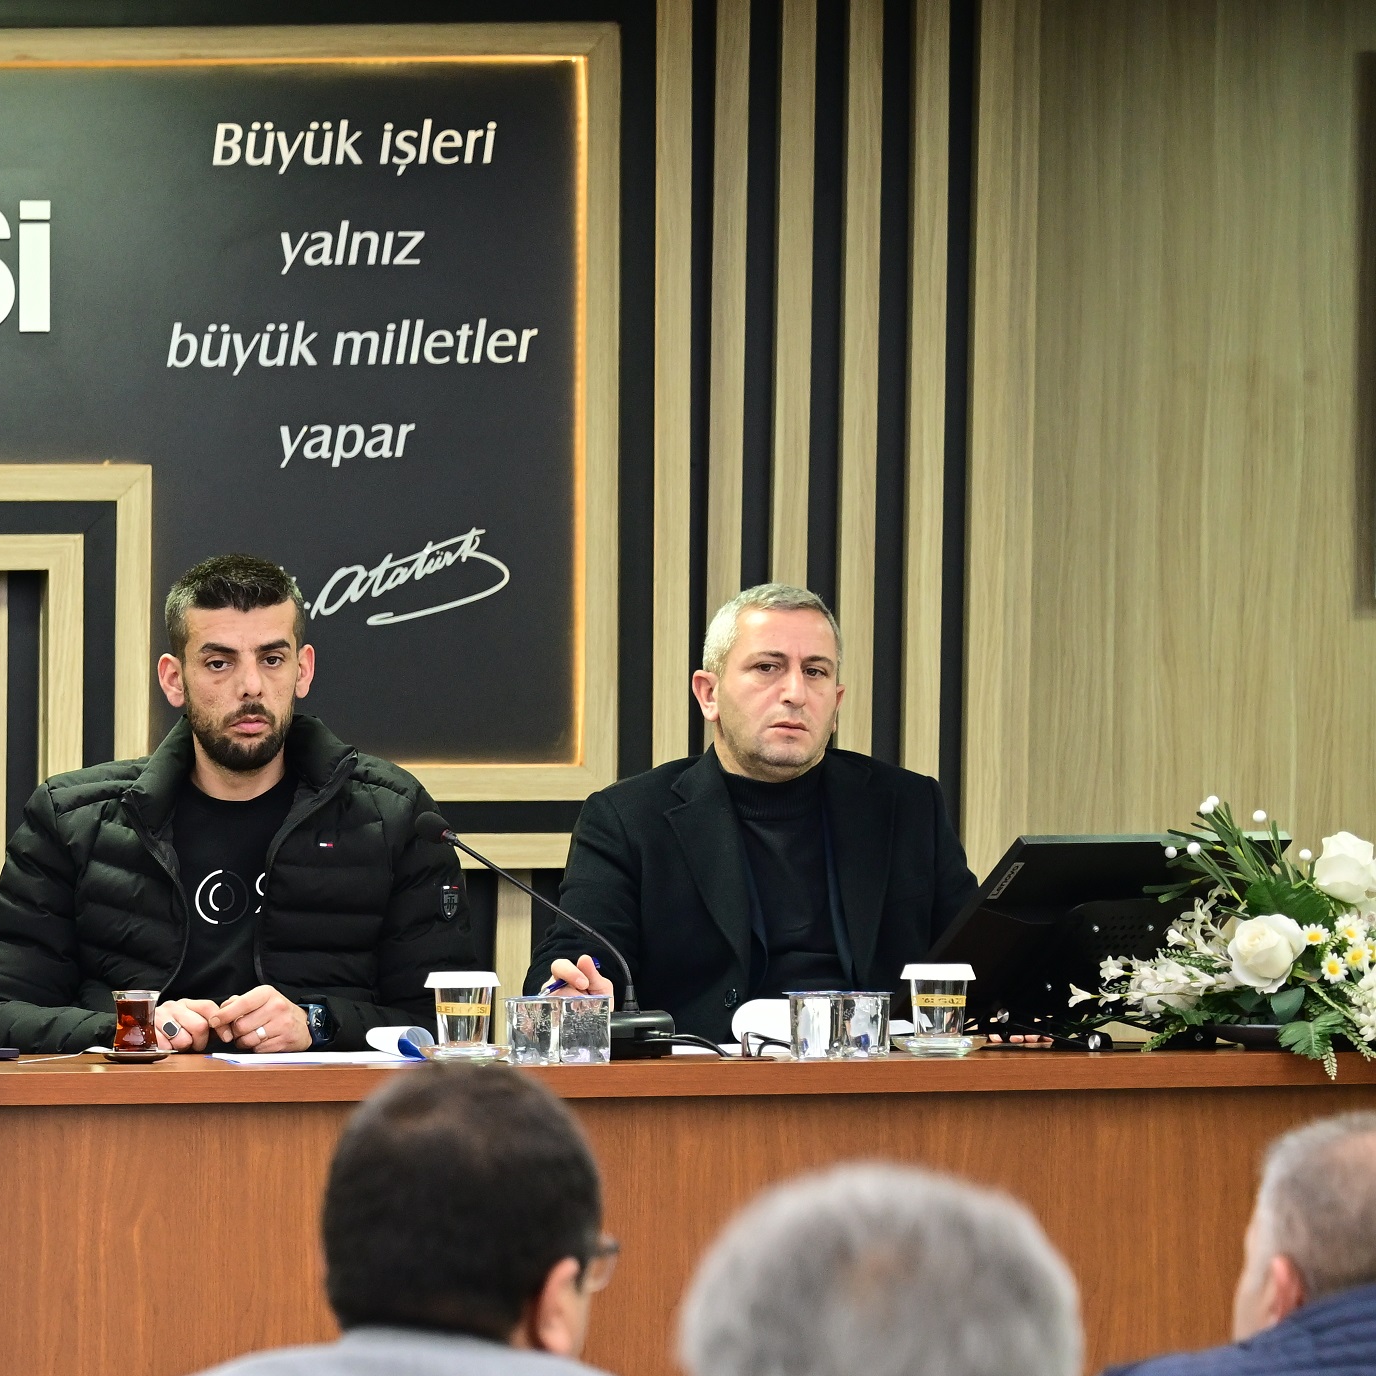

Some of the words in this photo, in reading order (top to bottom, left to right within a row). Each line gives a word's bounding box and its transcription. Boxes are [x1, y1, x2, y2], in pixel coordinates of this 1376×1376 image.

[212, 119, 363, 175] Büyük
[379, 119, 498, 176] işleri
[280, 220, 426, 275] yalnız
[166, 321, 318, 376] büyük
[332, 318, 539, 366] milletler
[279, 422, 416, 468] yapar
[991, 865, 1019, 897] Lenovo
